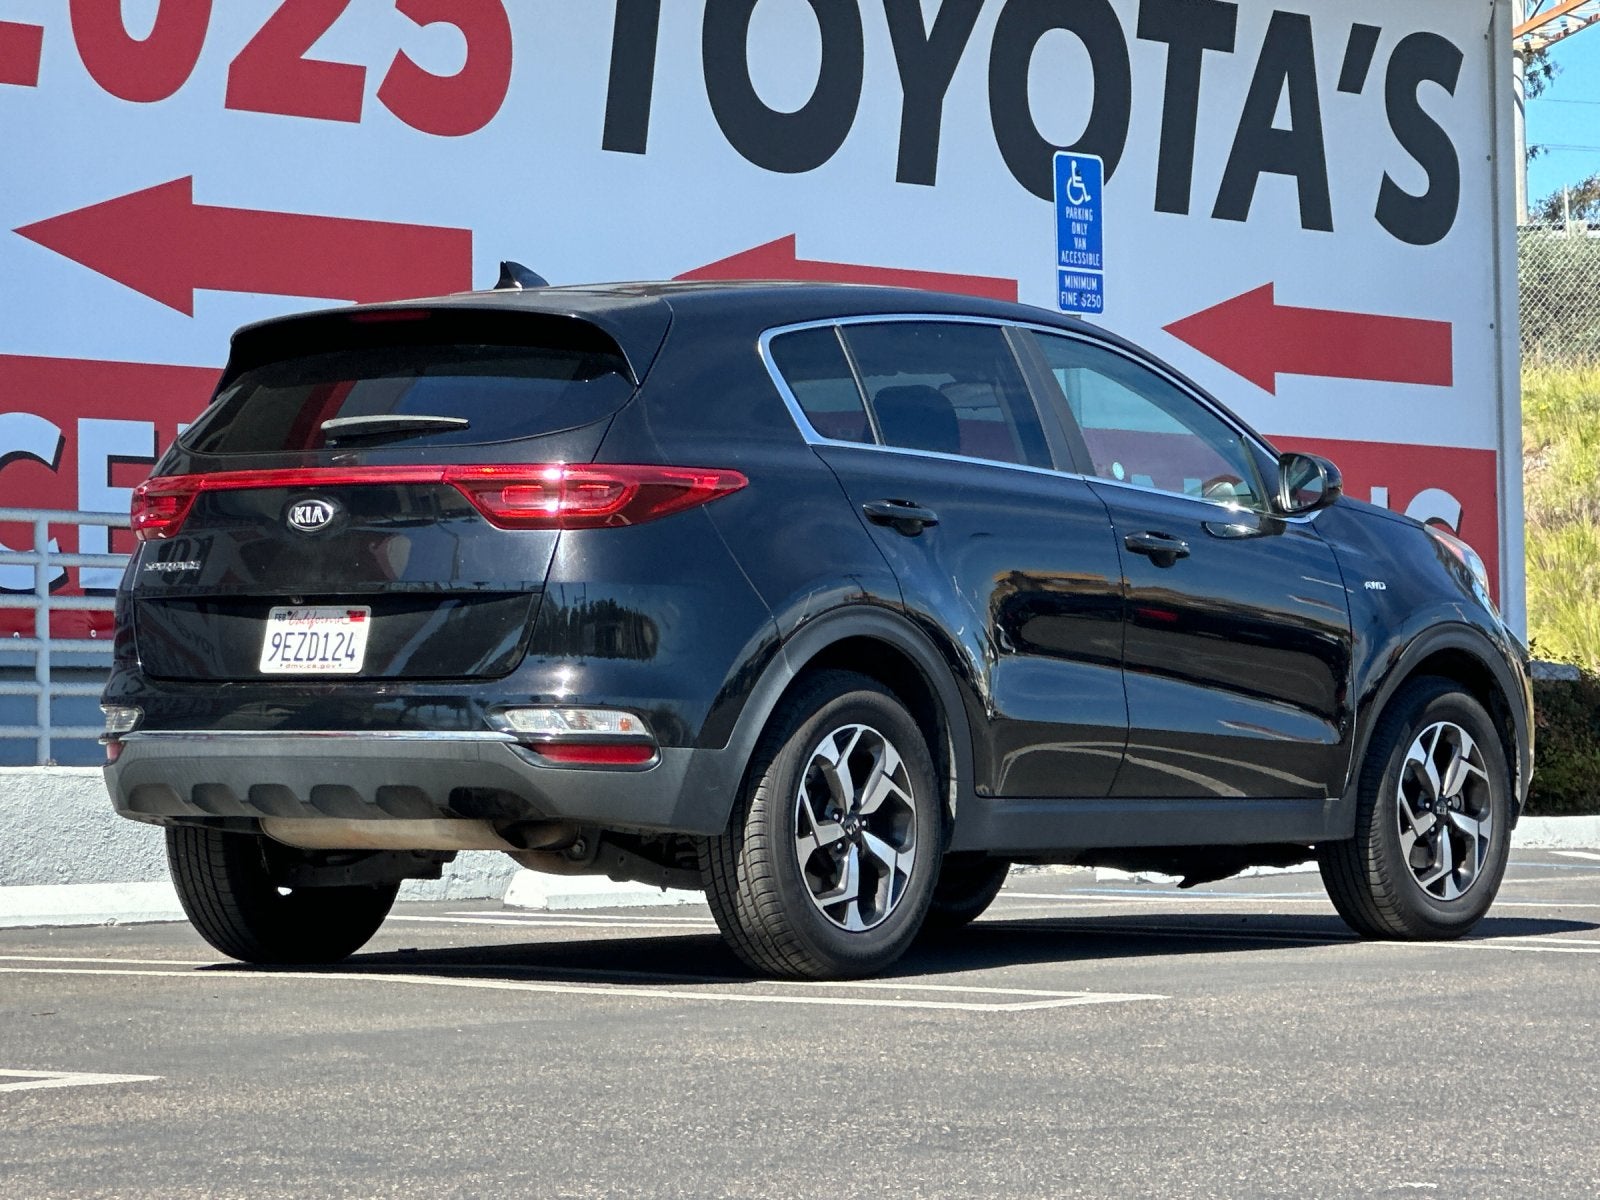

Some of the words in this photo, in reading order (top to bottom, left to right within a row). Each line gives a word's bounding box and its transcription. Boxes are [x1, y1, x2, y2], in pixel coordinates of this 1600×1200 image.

[1065, 206, 1093, 222] PARKING
[1071, 222, 1088, 235] ONLY
[1073, 237, 1087, 250] VAN
[1061, 251, 1101, 267] ACCESSIBLE
[1064, 274, 1098, 291] MINIMUM
[1061, 291, 1078, 306] FINE
[1080, 294, 1101, 308] $250
[293, 506, 325, 524] KIA
[288, 610, 350, 631] California
[268, 631, 356, 662] 9EZD124
